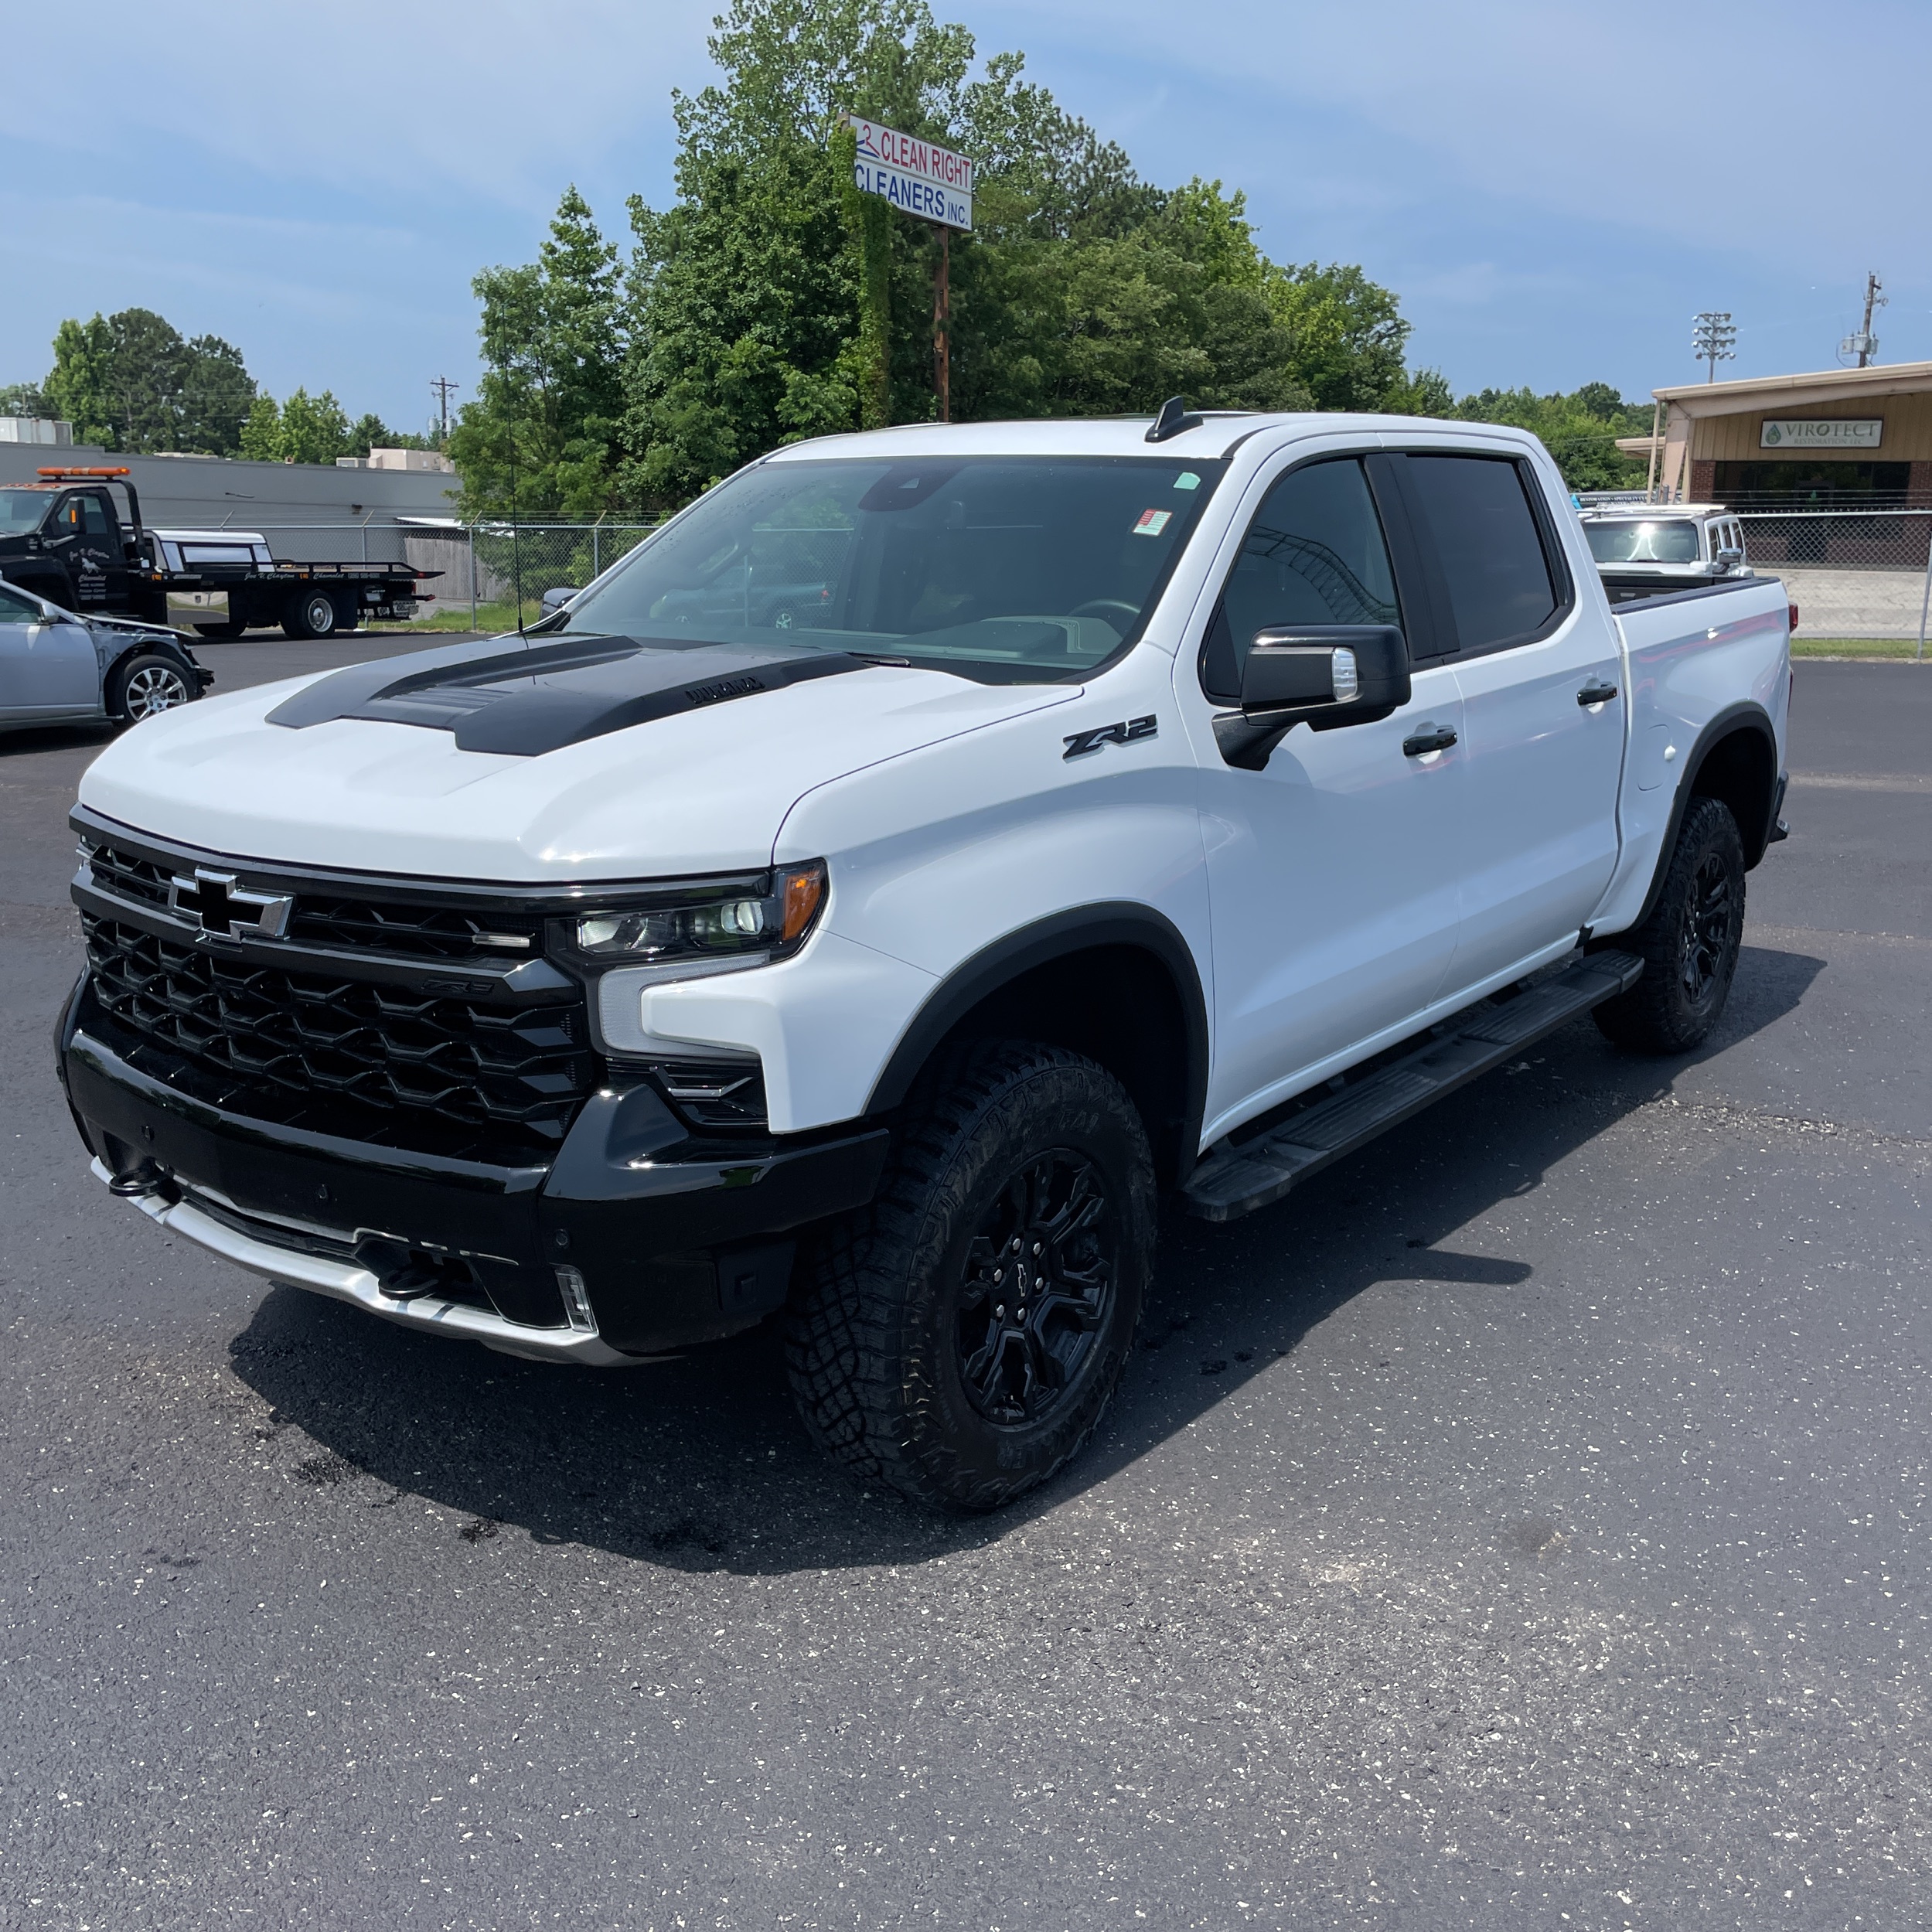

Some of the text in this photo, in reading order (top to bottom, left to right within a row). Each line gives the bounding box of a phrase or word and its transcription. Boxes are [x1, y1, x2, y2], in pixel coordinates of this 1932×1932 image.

[881, 131, 970, 188] CLEAN RIGHT
[854, 164, 968, 225] CLEANERS INC.
[1786, 423, 1878, 437] VIROTECT
[1062, 713, 1158, 760] ZR2
